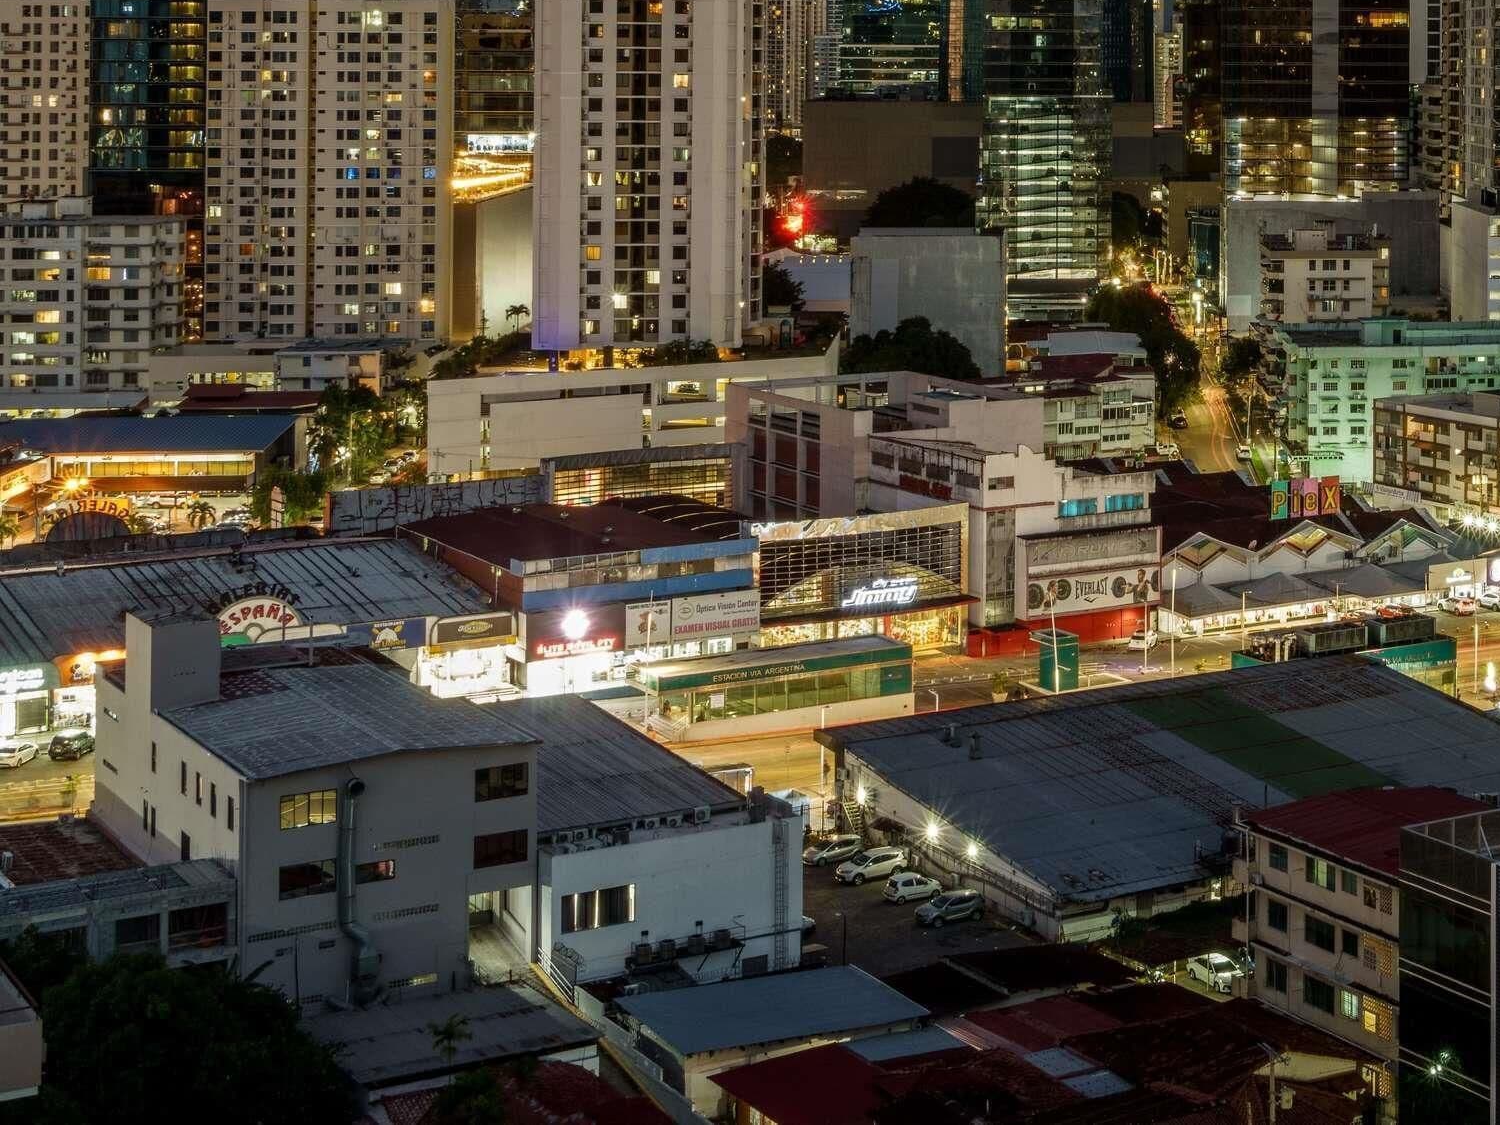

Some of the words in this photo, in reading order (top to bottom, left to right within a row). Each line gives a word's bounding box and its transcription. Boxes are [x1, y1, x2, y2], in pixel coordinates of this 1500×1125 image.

[1075, 576, 1109, 600] EVERLAST
[219, 603, 295, 636] ESPAÑA
[674, 623, 703, 635] EXAMEN
[704, 619, 731, 632] VISUAL
[732, 615, 758, 628] GRATIS
[765, 663, 805, 675] ARGENTINA
